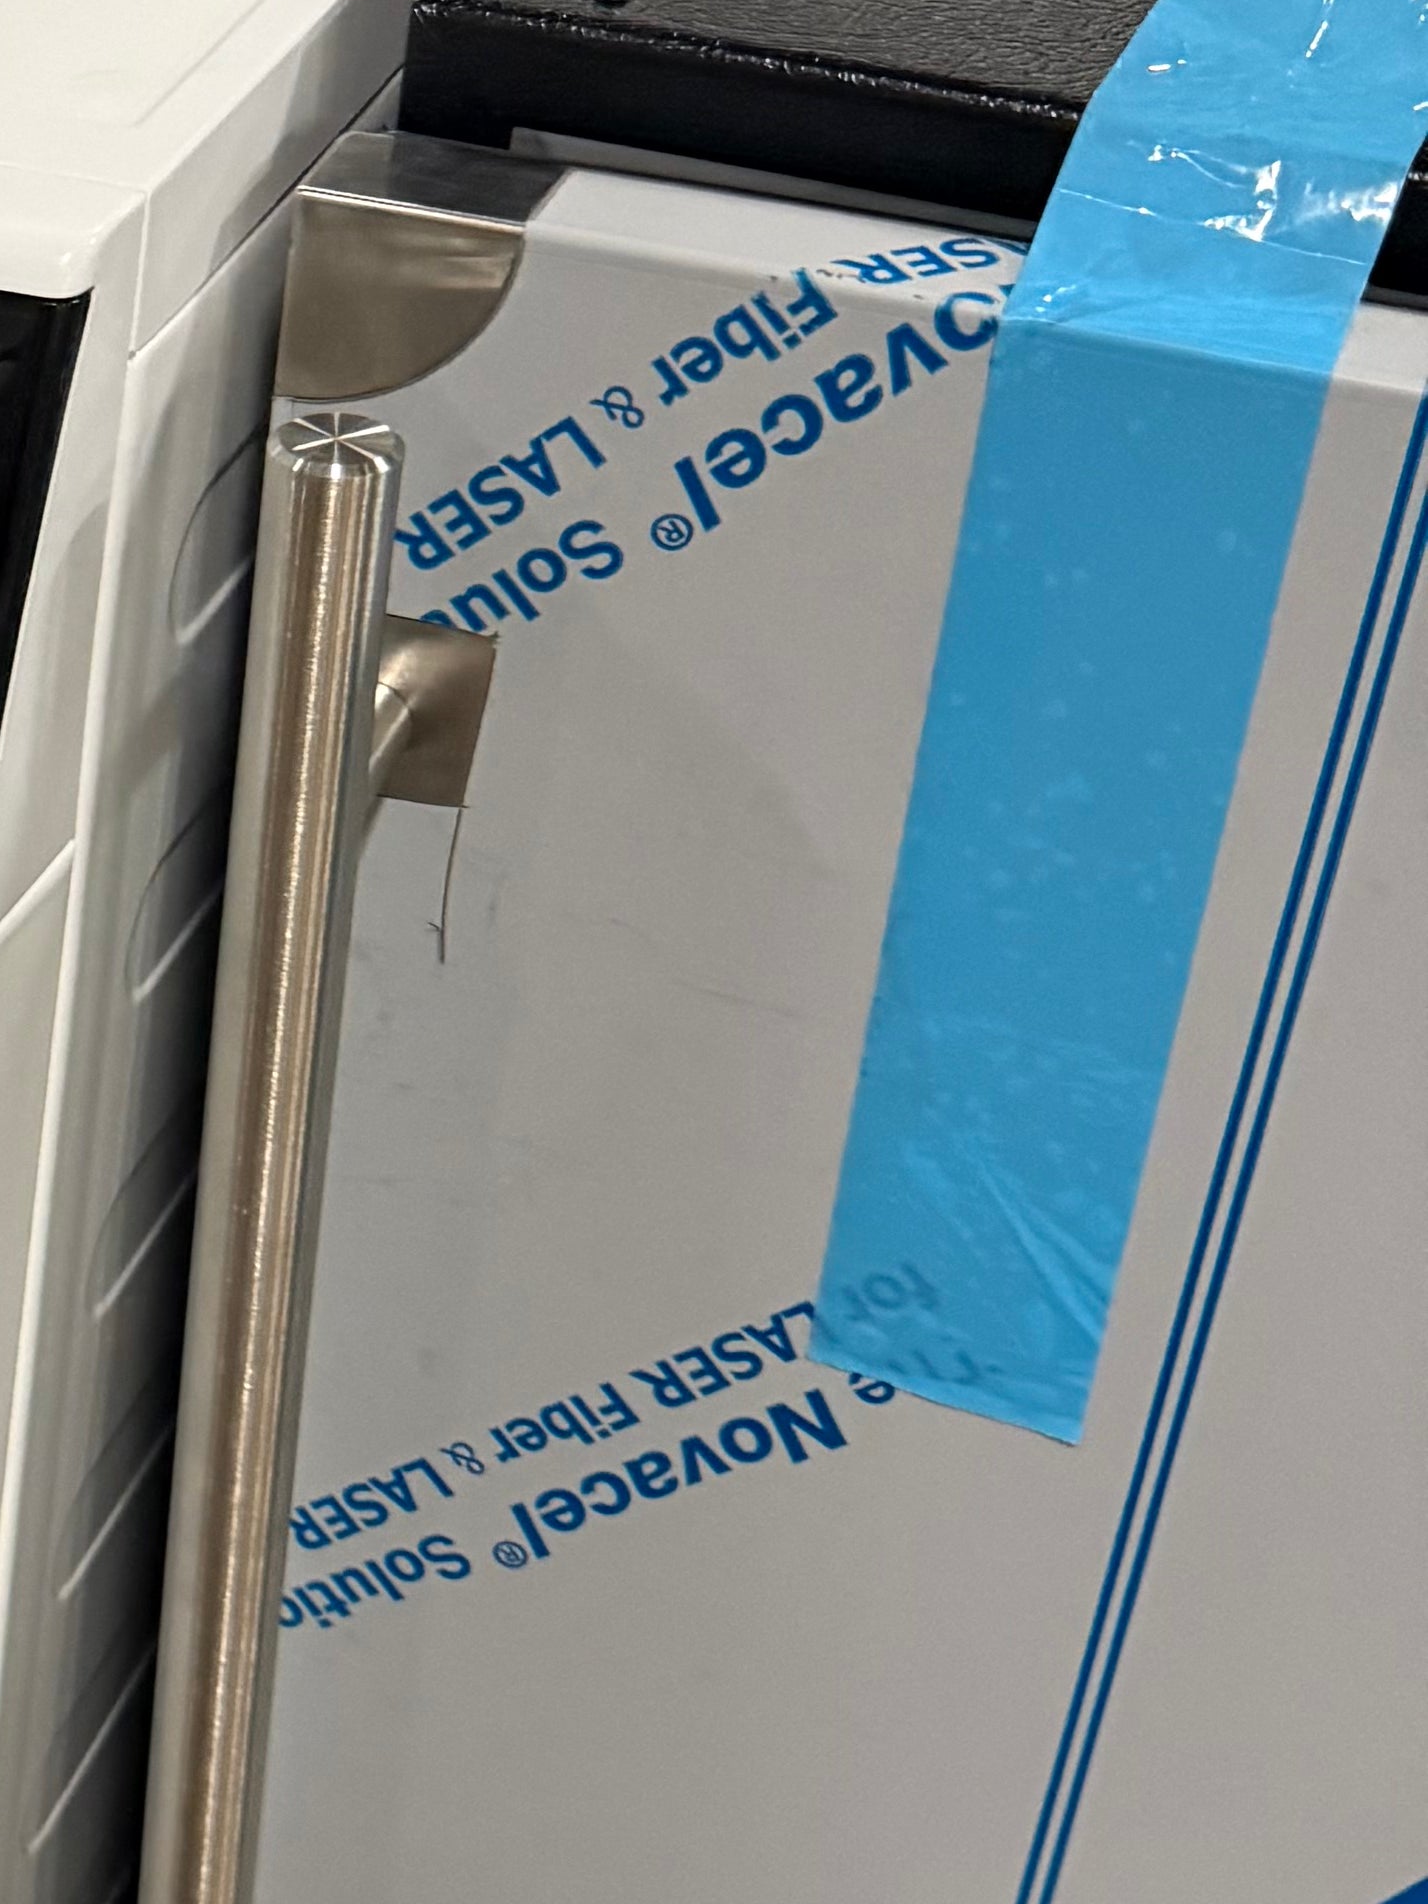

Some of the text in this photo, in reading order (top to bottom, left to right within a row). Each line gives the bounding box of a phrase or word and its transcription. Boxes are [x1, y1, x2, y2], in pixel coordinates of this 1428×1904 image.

[653, 267, 839, 405] Fiber
[591, 384, 646, 430] &
[650, 285, 1012, 552] ovacel®
[394, 414, 609, 571] LASER
[440, 1440, 486, 1476] &
[490, 1381, 641, 1463] Fiber
[286, 1456, 456, 1551] LASER
